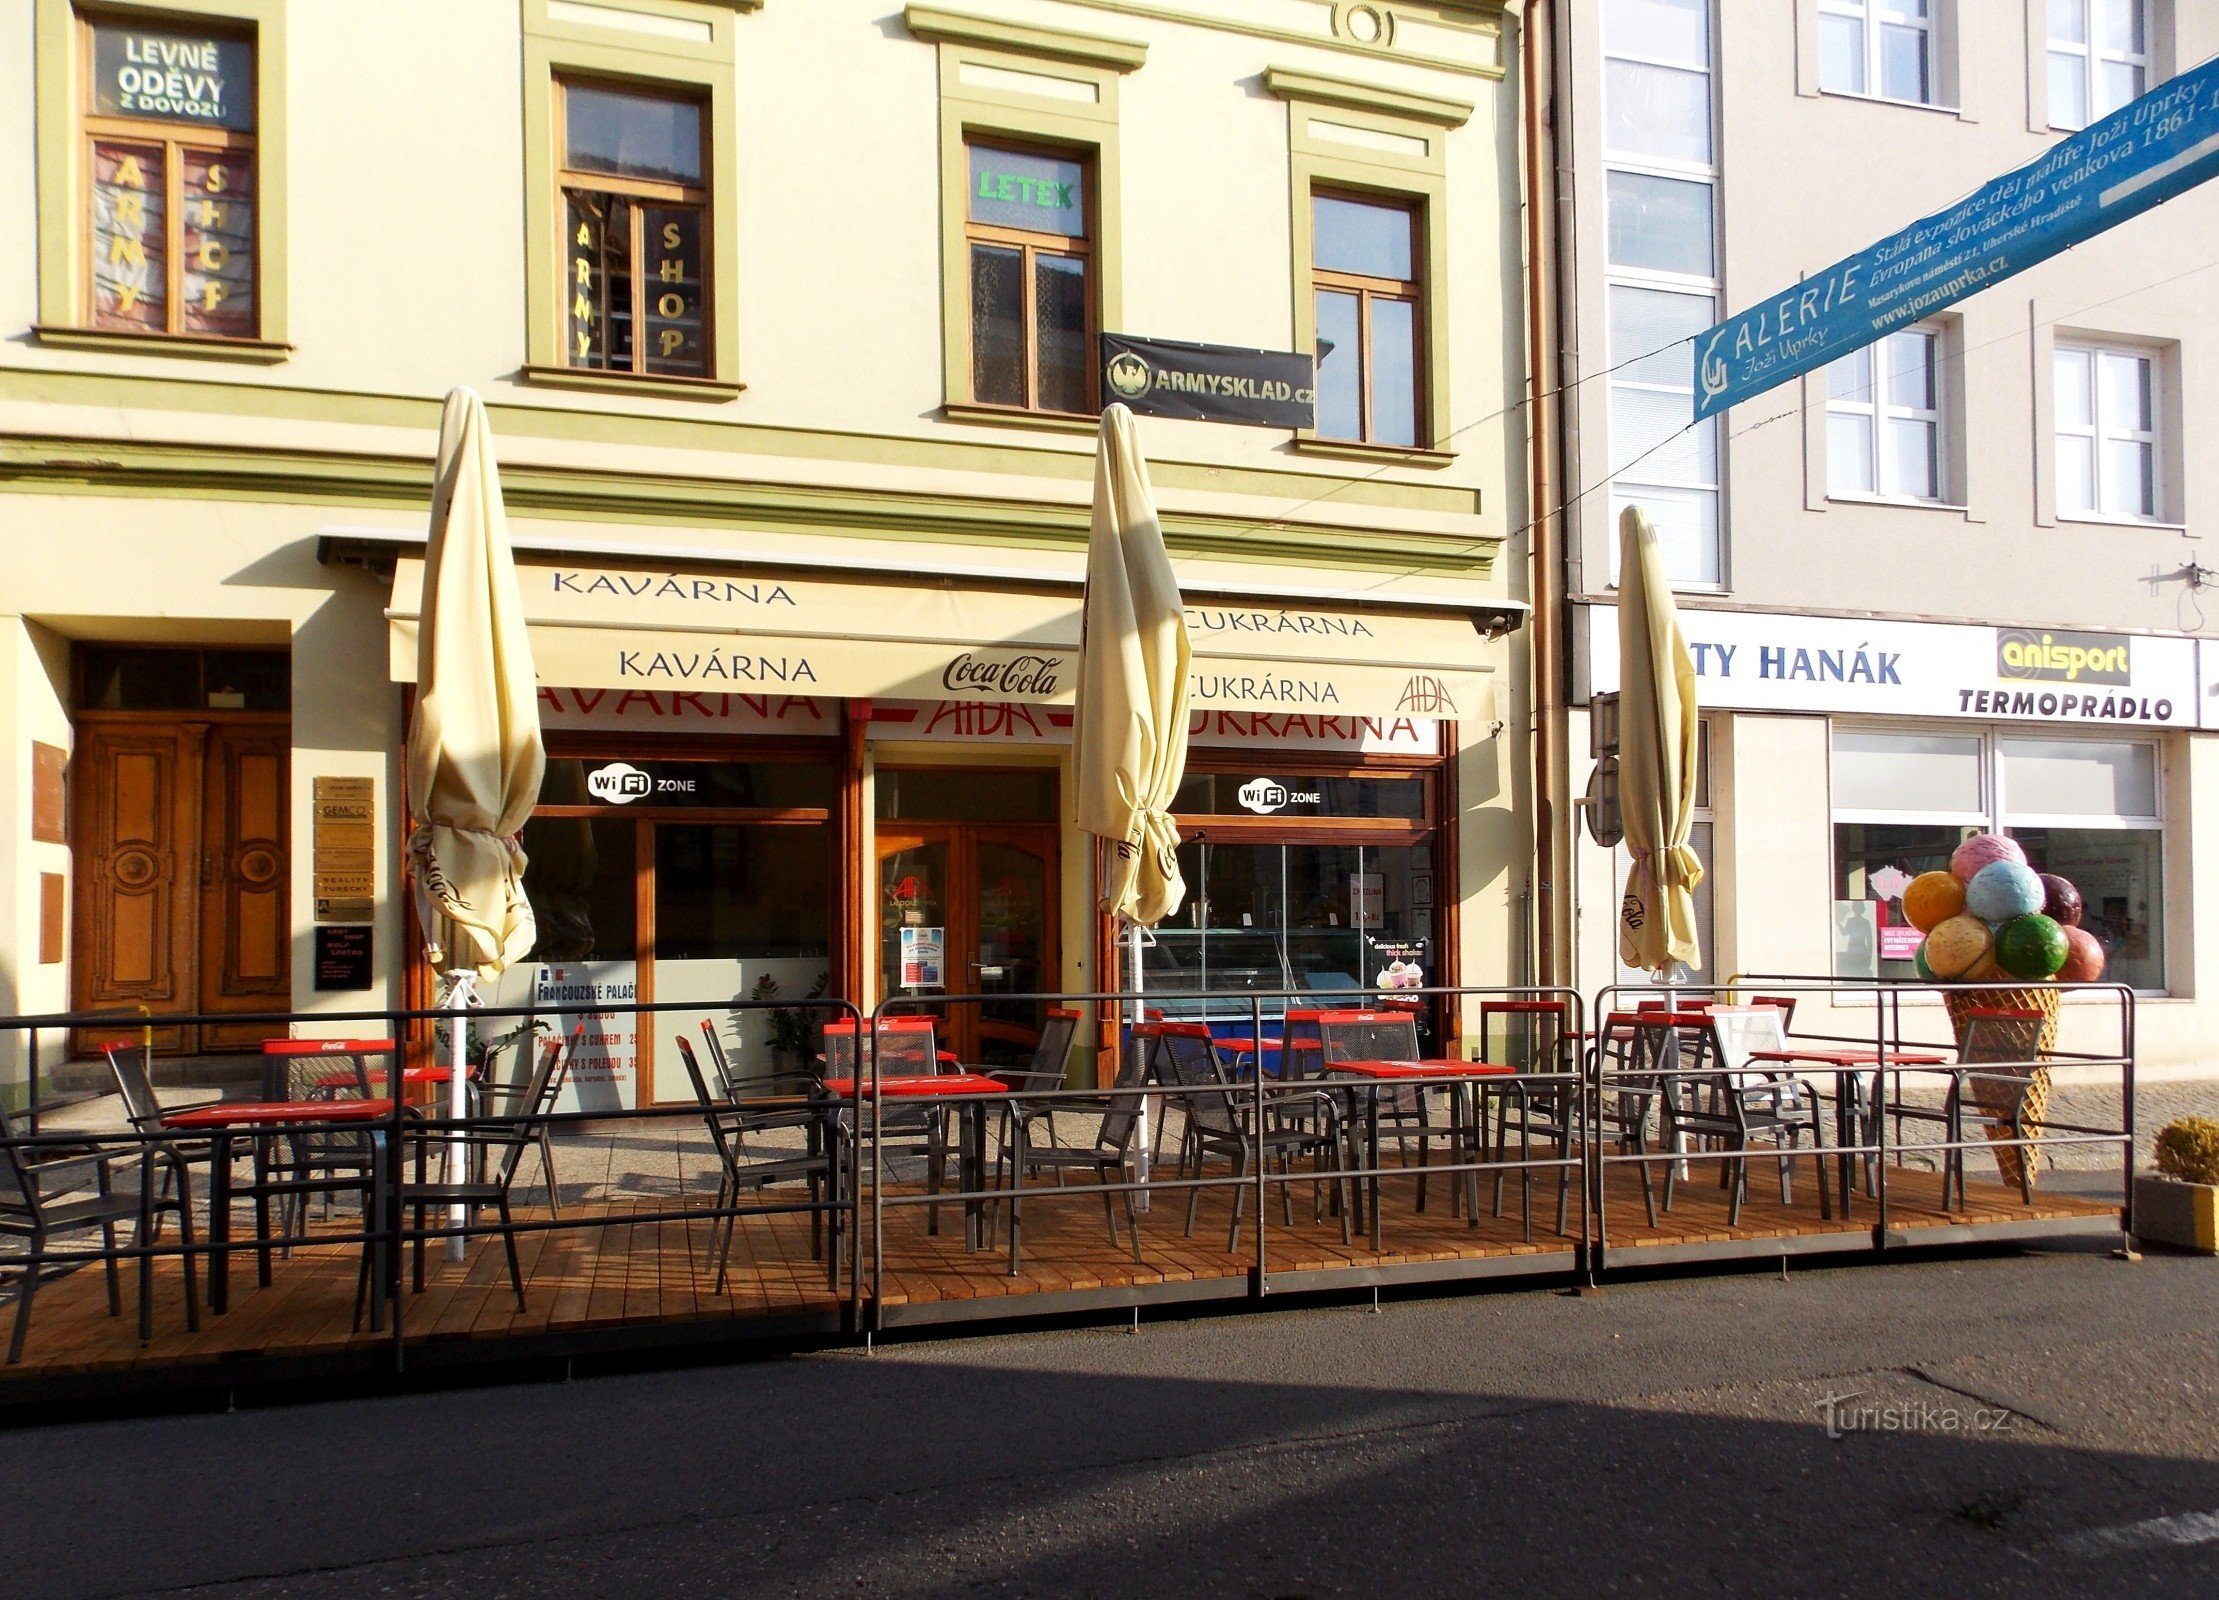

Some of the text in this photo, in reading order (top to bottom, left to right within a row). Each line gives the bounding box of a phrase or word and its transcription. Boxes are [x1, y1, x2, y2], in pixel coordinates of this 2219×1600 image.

[126, 36, 219, 73] LEVNÉ
[117, 65, 225, 105] ODĚVY
[120, 93, 227, 119] Z DOVOZU
[979, 170, 1075, 210] LETEX
[1874, 78, 2207, 266] Stálá expozice děl malíře Joži Uprky
[110, 155, 146, 313] ARMY
[1869, 242, 1943, 288] Evropana
[1946, 188, 2046, 249] slováckého
[2050, 140, 2134, 196] venkova
[199, 163, 230, 312] SHOP
[1868, 276, 1922, 310] Masarykovo
[1981, 221, 2029, 253] Uherské
[574, 220, 595, 359] ARMY
[658, 222, 686, 357] SHOP
[1872, 255, 2009, 330] www.jozauprka.cz
[1742, 326, 1829, 381] Joži Uprky
[1155, 369, 1315, 405] ARMYSKLAD.cz
[553, 572, 797, 606] KAVÁRNA
[619, 647, 817, 683] KAVÁRNA
[942, 652, 1065, 695] Coca-Cola
[1759, 640, 1903, 686] HANÁK
[2003, 634, 2129, 681] anisport
[1394, 674, 1459, 714] AIDA
[1958, 688, 2174, 722] TERMOPRÁDLO
[657, 779, 697, 793] ZONE
[1290, 792, 1321, 804] ZONE
[323, 805, 366, 816] GEMCO
